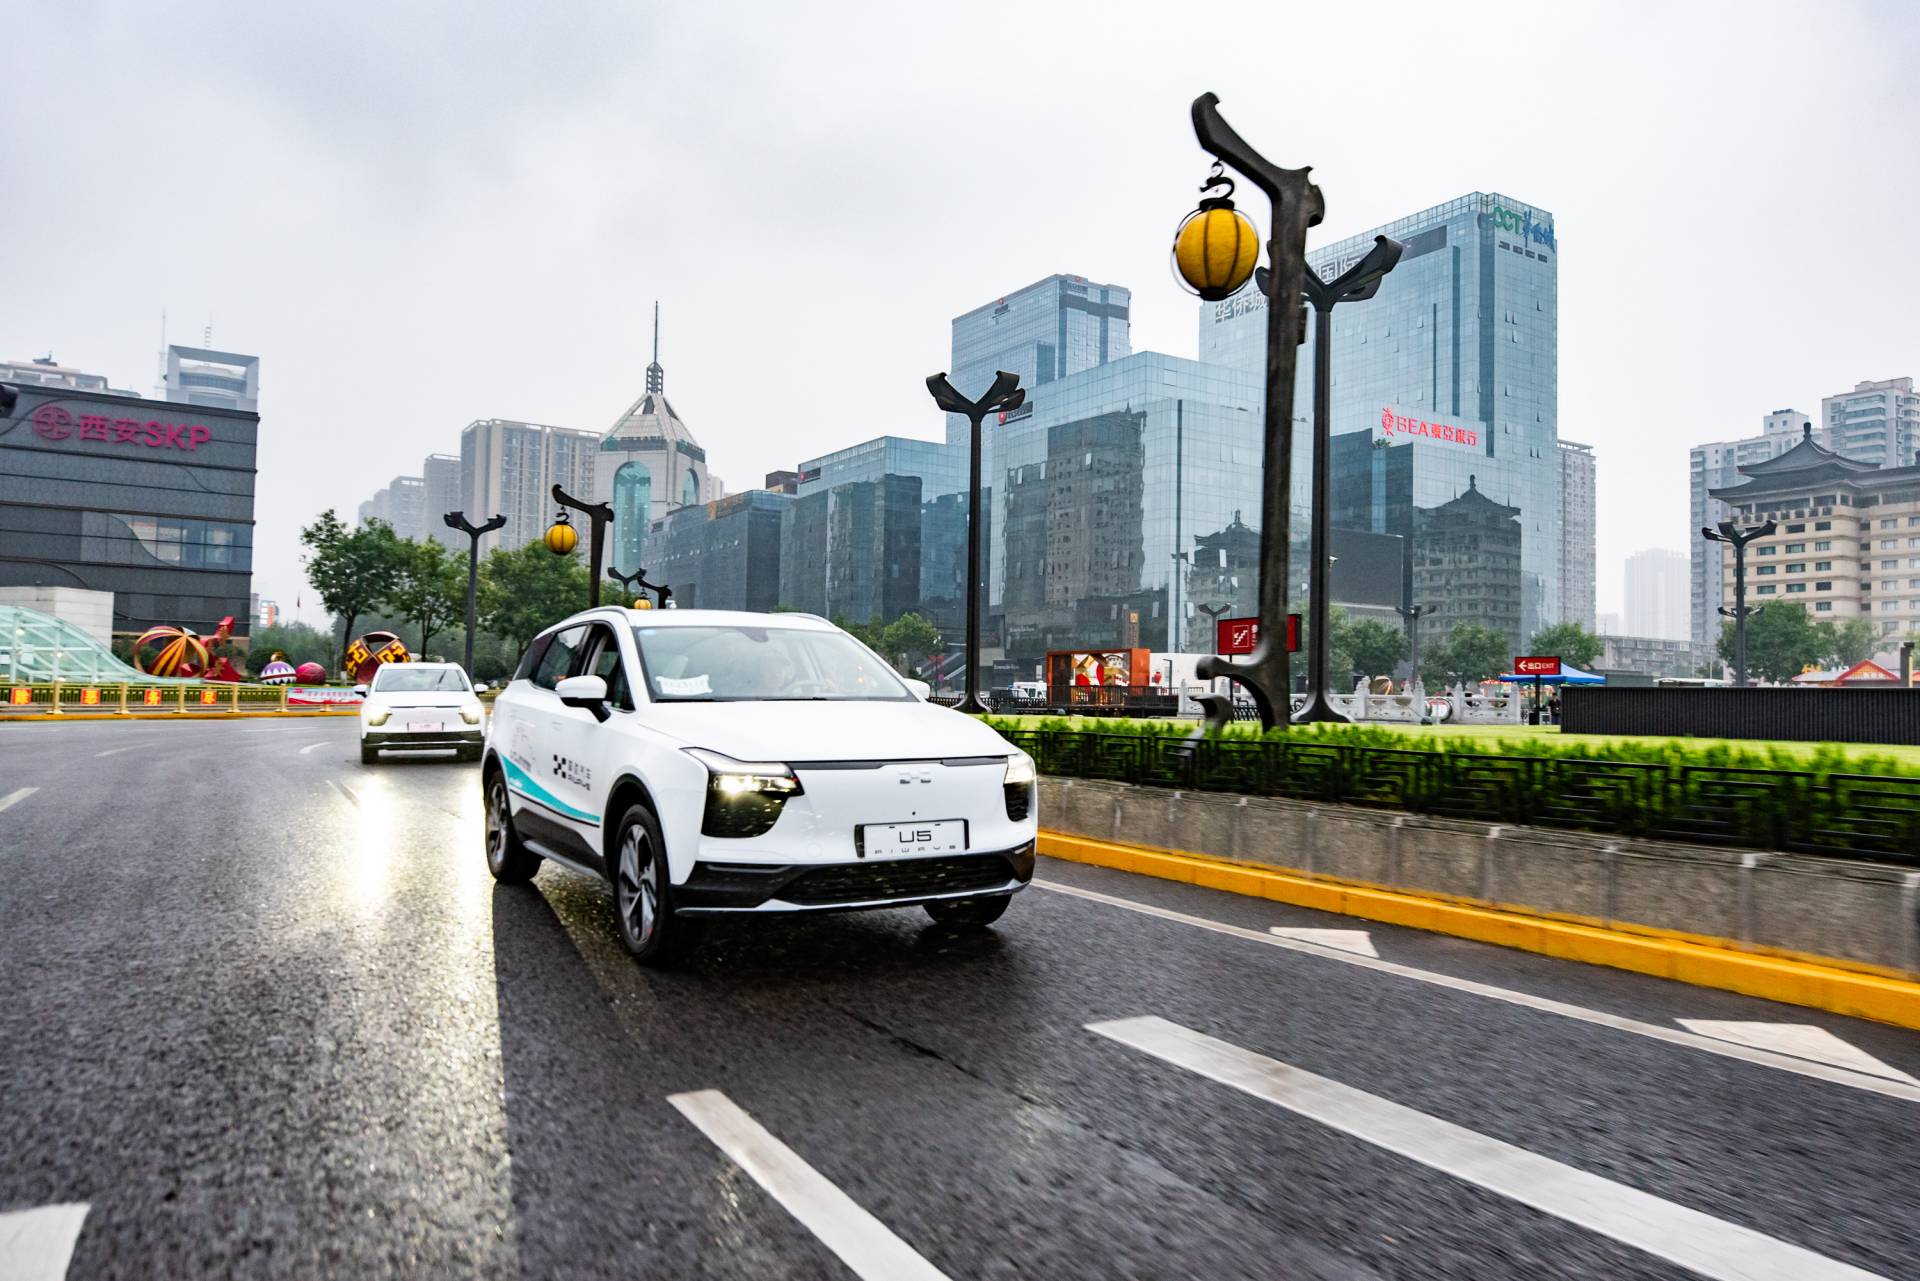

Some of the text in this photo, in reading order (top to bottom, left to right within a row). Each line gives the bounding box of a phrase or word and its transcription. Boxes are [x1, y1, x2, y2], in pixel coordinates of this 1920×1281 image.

[79, 415, 211, 451] 西安SKP
[1397, 416, 1429, 437] BEA
[899, 830, 932, 843] U5
